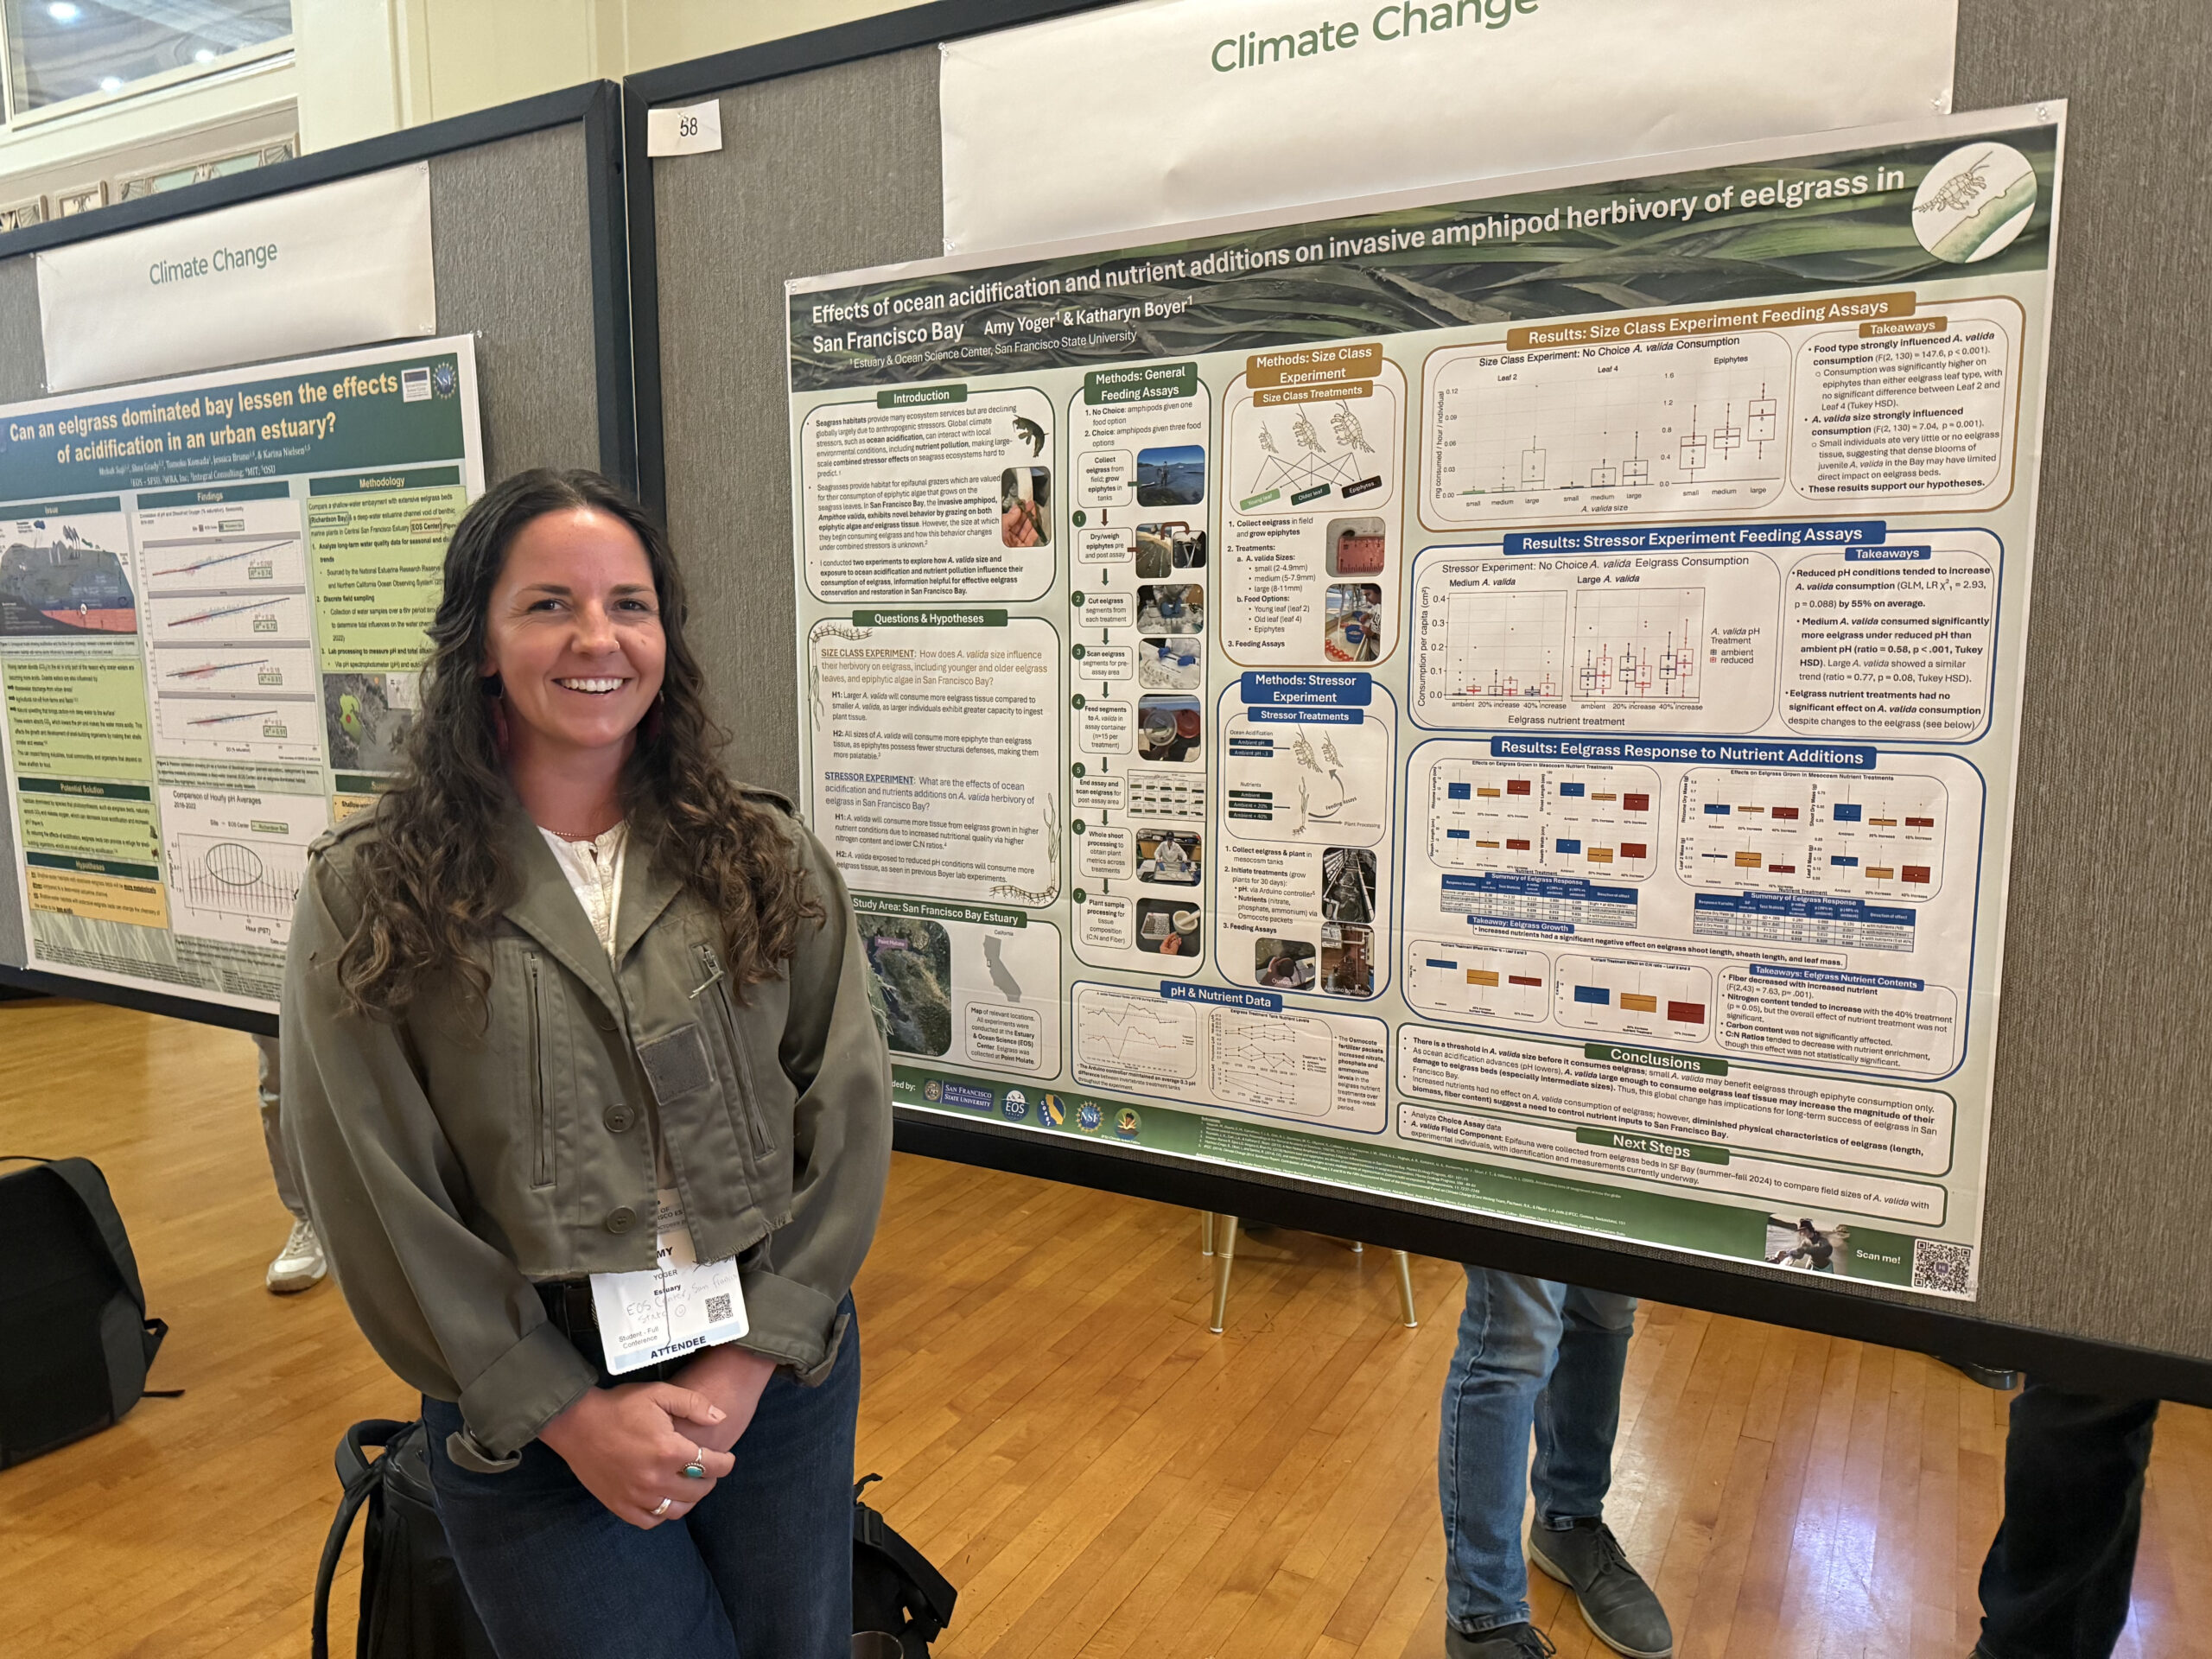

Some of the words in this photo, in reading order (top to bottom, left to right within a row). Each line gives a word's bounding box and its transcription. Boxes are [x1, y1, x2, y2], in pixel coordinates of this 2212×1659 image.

[1211, 21, 1359, 73] Climate
[679, 117, 698, 137] 58
[812, 302, 869, 324] Effects
[873, 296, 890, 316] of
[893, 294, 944, 314] ocean
[949, 277, 1060, 308] acidification
[1065, 269, 1101, 292] and
[1106, 259, 1185, 288] nutrient
[1191, 248, 1290, 276] additions
[1295, 244, 1323, 262] on
[1330, 229, 1425, 258] invasive
[1432, 207, 1559, 246] amphipod
[1567, 196, 1698, 229] herbivory
[1704, 186, 1734, 212] of
[1740, 175, 1868, 208] eelgrass
[1877, 166, 1904, 191] in
[149, 257, 208, 285] Climate
[213, 244, 277, 272] Change
[984, 321, 1015, 336] Amy
[1063, 308, 1074, 327] &
[1077, 307, 1141, 325] Katharyn
[1529, 328, 1586, 344] Results:
[1590, 325, 1620, 339] Size
[1624, 321, 1666, 335] Class
[1669, 312, 1759, 333] Experiment
[1762, 306, 1826, 323] Feeding
[1827, 302, 1889, 318] Assays
[1871, 322, 1936, 334] Takeaways
[813, 335, 842, 353] San
[848, 327, 927, 350] Francisco
[931, 321, 964, 343] Bay
[886, 354, 893, 365] &
[894, 352, 923, 365] Ocean
[925, 347, 959, 362] Science
[961, 346, 994, 358] Center,
[995, 343, 1013, 354] San
[1014, 339, 1060, 353] Francisco
[1061, 336, 1087, 347] State
[1089, 329, 1138, 346] University
[1256, 353, 1310, 368] Methods:
[1312, 351, 1336, 363] Size
[1338, 347, 1372, 360] Class
[1096, 371, 1143, 385] Methods:
[1145, 365, 1185, 380] General
[1280, 367, 1346, 384] Experiment
[893, 390, 950, 404] Introduction
[1101, 388, 1141, 401] Feeding
[1142, 386, 1179, 398] Assays
[1262, 393, 1281, 403] Size
[1282, 391, 1308, 401] Class
[1310, 386, 1363, 398] Treatments
[10, 423, 35, 442] Can
[38, 423, 55, 438] an
[58, 414, 118, 436] eelgrass
[121, 397, 200, 427] dominated
[205, 397, 233, 419] bay
[238, 390, 293, 412] lessen
[298, 382, 327, 404] the
[333, 372, 397, 399] effects
[57, 443, 70, 464] of
[75, 435, 163, 462] acidification
[167, 431, 182, 451] in
[187, 432, 206, 448] an
[210, 424, 257, 446] urban
[261, 411, 336, 440] estuary?
[359, 476, 405, 488] Methodology
[1808, 485, 1835, 493] These
[1837, 484, 1869, 493] results
[1871, 482, 1907, 492] support
[1926, 479, 1987, 490] hypotheses.
[1522, 536, 1580, 550] Results:
[1583, 535, 1646, 548] Stressor
[1649, 531, 1736, 548] Experiment
[1739, 528, 1802, 544] Feeding
[1803, 528, 1863, 543] Assays
[1856, 549, 1920, 560] Takeaways
[1577, 575, 1601, 586] Large
[1603, 575, 1611, 583] A.
[1615, 574, 1640, 583] valida
[874, 613, 919, 625] Questions
[920, 613, 928, 624] &
[930, 613, 984, 626] Hypotheses
[1255, 674, 1306, 685] Methods:
[1308, 675, 1357, 686] Stressor
[1273, 691, 1338, 704] Experiment
[1261, 710, 1297, 720] Stressor
[1298, 711, 1350, 721] Treatments
[1508, 715, 1545, 726] Eelgrass
[1582, 717, 1625, 726] treatment
[1501, 741, 1557, 754] Results:
[1560, 742, 1621, 758] Eelgrass
[1624, 744, 1698, 760] Response
[1700, 747, 1716, 760] to
[1719, 747, 1784, 761] Nutrient
[1787, 749, 1864, 764] Additions
[853, 898, 878, 911] Study
[879, 900, 901, 912] Area:
[902, 903, 919, 913] San
[921, 905, 963, 918] Francisco
[965, 909, 982, 922] Bay
[983, 911, 1019, 926] Estuary
[1171, 986, 1185, 998] pH
[1187, 988, 1196, 998] &
[1198, 988, 1243, 1004] Nutrient
[1245, 994, 1271, 1007] Data
[1611, 1048, 1700, 1071] Conclusions
[1006, 1100, 1026, 1115] EOS
[1079, 1111, 1099, 1123] NSF
[1613, 1135, 1647, 1150] Next
[1649, 1141, 1690, 1158] Steps
[1856, 1249, 1880, 1261] Scan
[1882, 1255, 1901, 1264] me!
[622, 1335, 658, 1349] Conference
[651, 1336, 707, 1359] ATTENDEE
